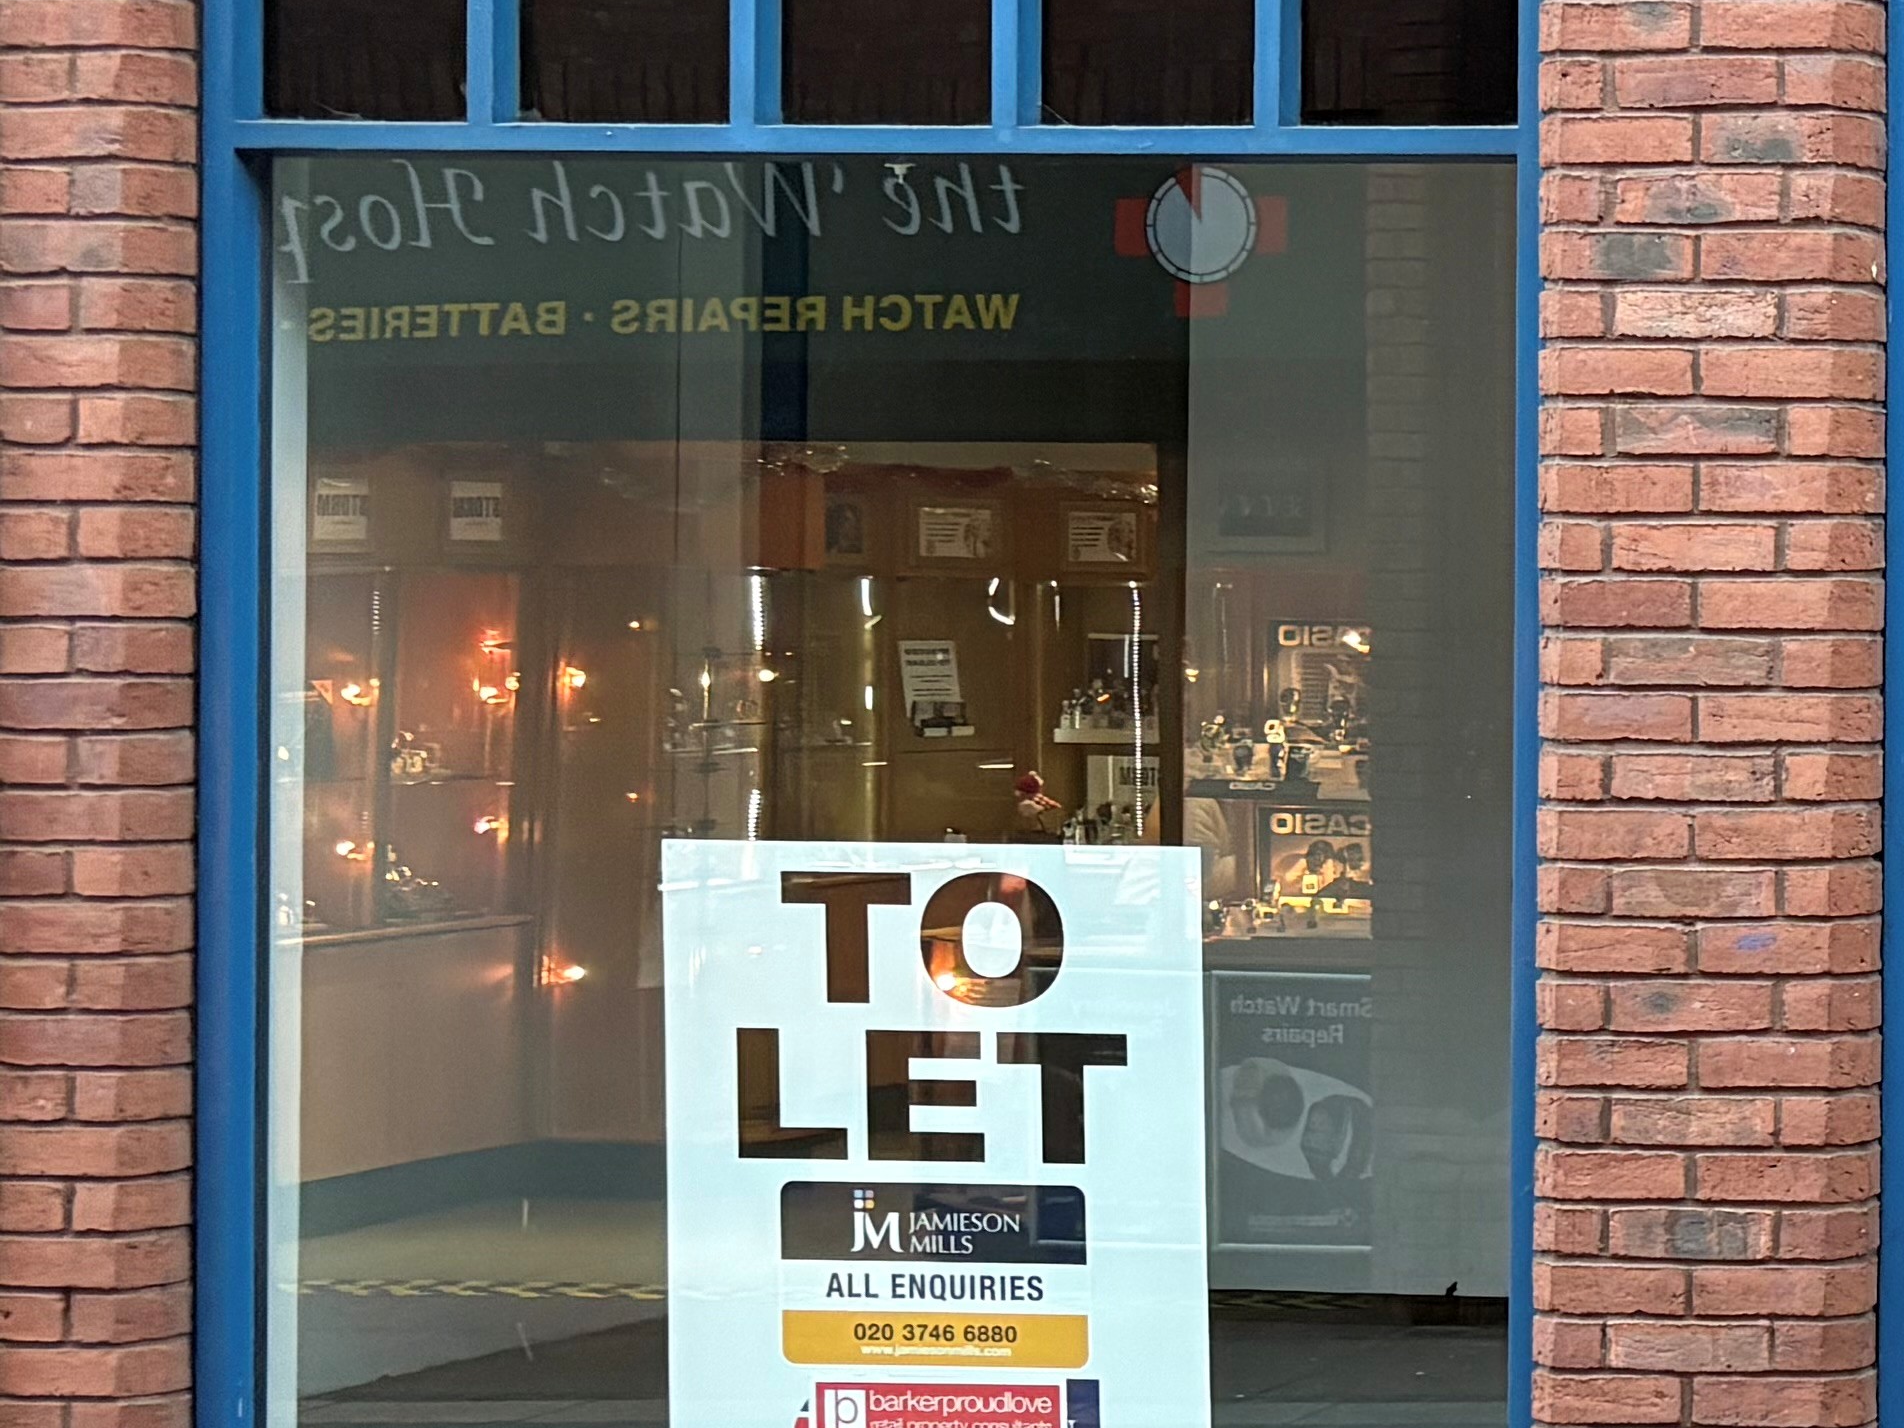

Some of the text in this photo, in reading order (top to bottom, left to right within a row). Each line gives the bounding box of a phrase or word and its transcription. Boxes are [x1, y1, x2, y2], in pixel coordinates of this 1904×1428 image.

[780, 871, 1064, 1008] TO
[736, 1027, 1128, 1165] LET
[909, 1212, 1020, 1233] JAMIESON
[910, 1235, 974, 1254] MILLS
[826, 1273, 1044, 1302] ALL ENQUIRIES
[854, 1323, 1018, 1343] 020 3746 6880
[869, 1390, 1053, 1416] barkerproudlove
